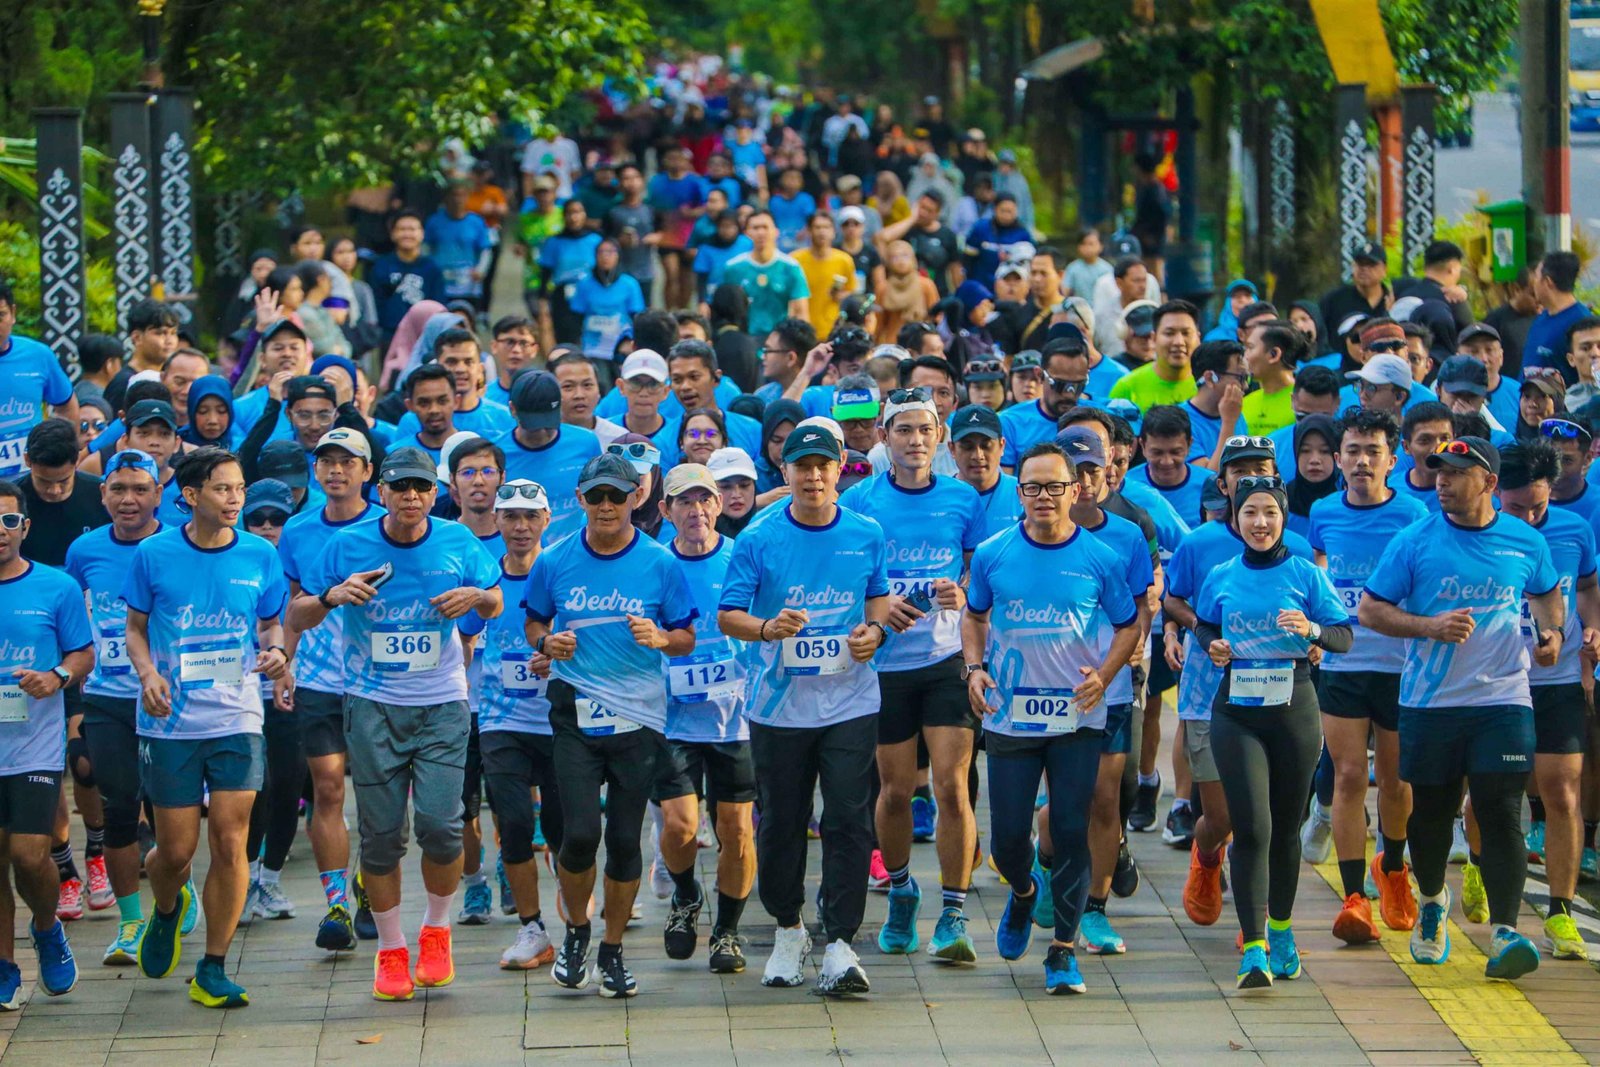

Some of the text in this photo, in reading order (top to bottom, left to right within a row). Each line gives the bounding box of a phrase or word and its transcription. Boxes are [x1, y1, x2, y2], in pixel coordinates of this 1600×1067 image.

[784, 584, 855, 607] Dedra
[1437, 574, 1516, 603] Dedra
[564, 585, 645, 616] Dedra
[173, 604, 248, 631] Dedra
[385, 635, 431, 655] 366
[795, 639, 840, 659] 059
[184, 656, 237, 667] Running Mate
[684, 664, 727, 687] 112
[1236, 674, 1288, 684] Running Mate
[3, 691, 23, 699] Mate
[1025, 698, 1068, 717] 002
